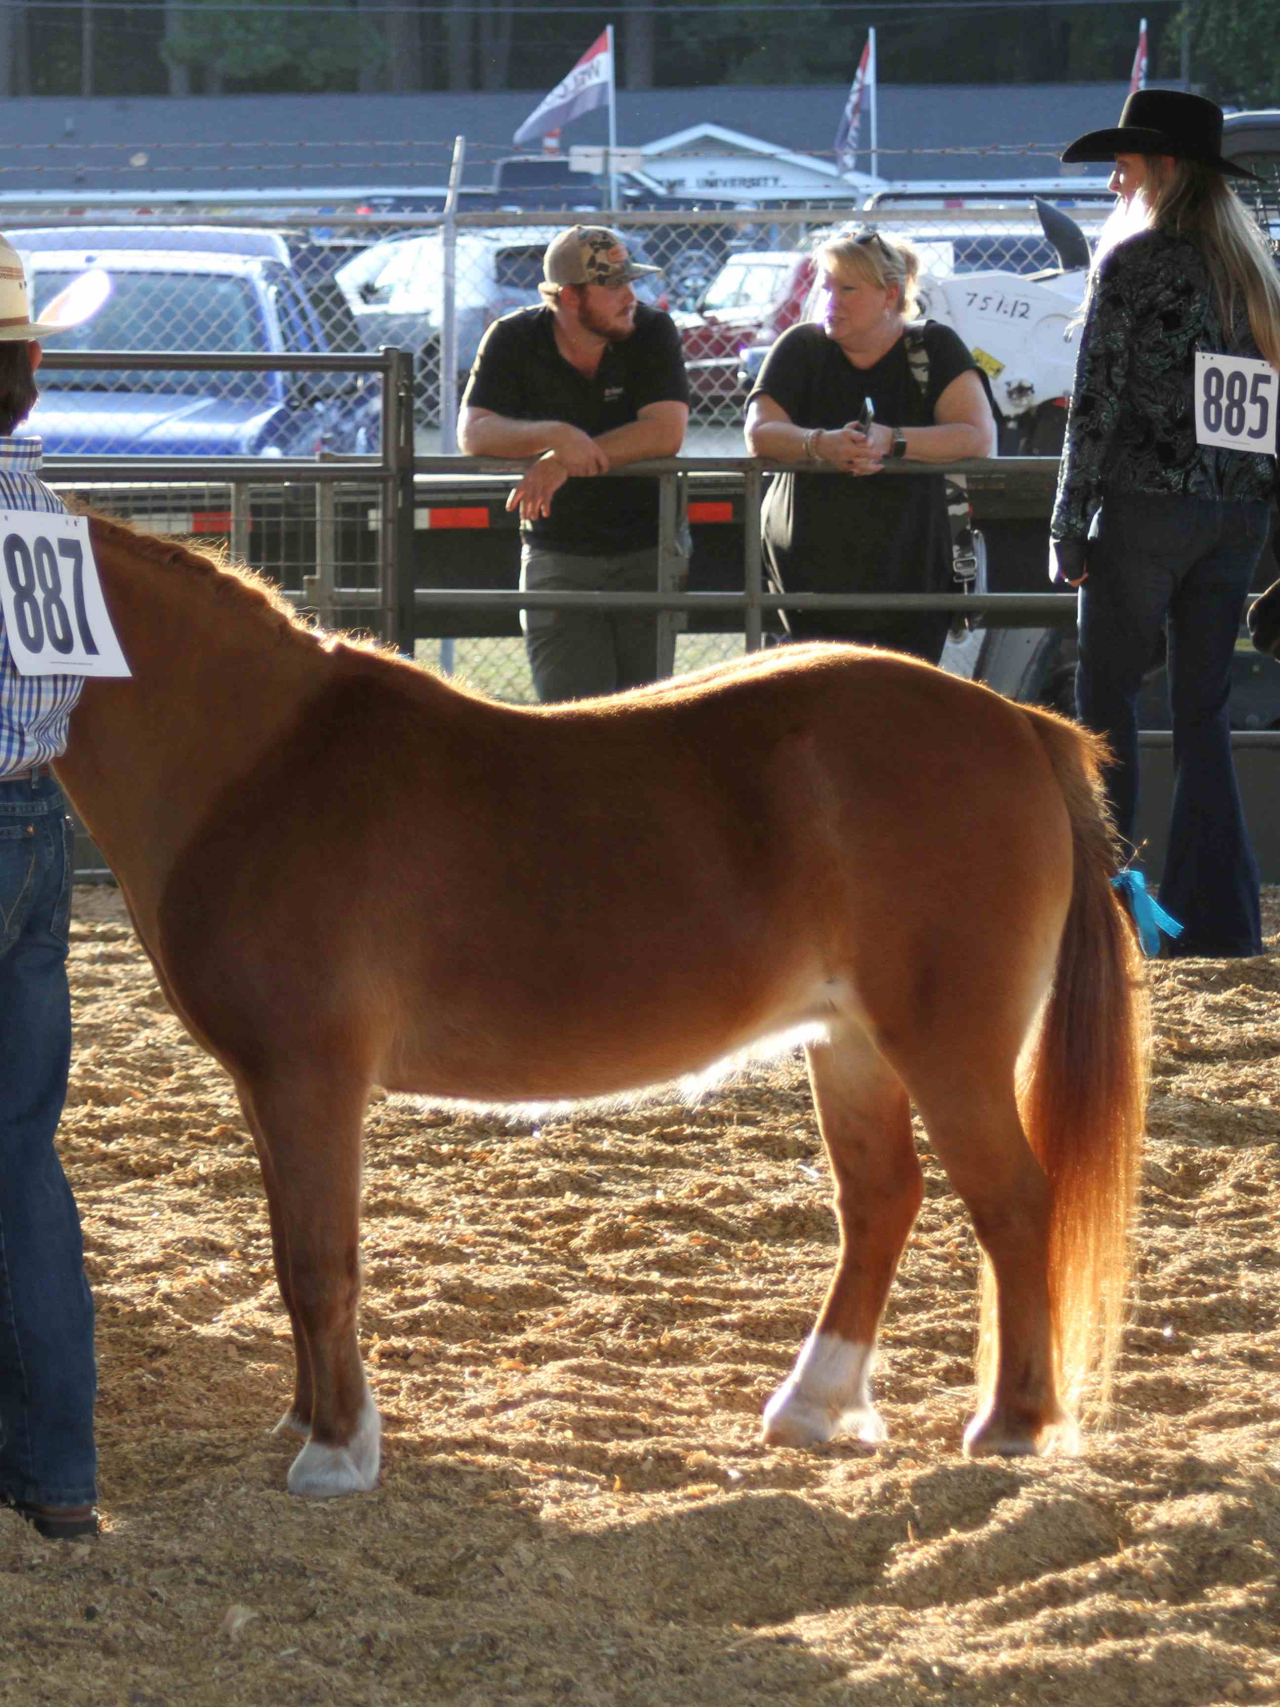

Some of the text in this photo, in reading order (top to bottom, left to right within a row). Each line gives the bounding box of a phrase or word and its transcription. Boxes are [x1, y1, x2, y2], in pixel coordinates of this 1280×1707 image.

[696, 175, 780, 189] UNIVERSITY
[1203, 367, 1271, 439] 885
[4, 533, 100, 655] 887
